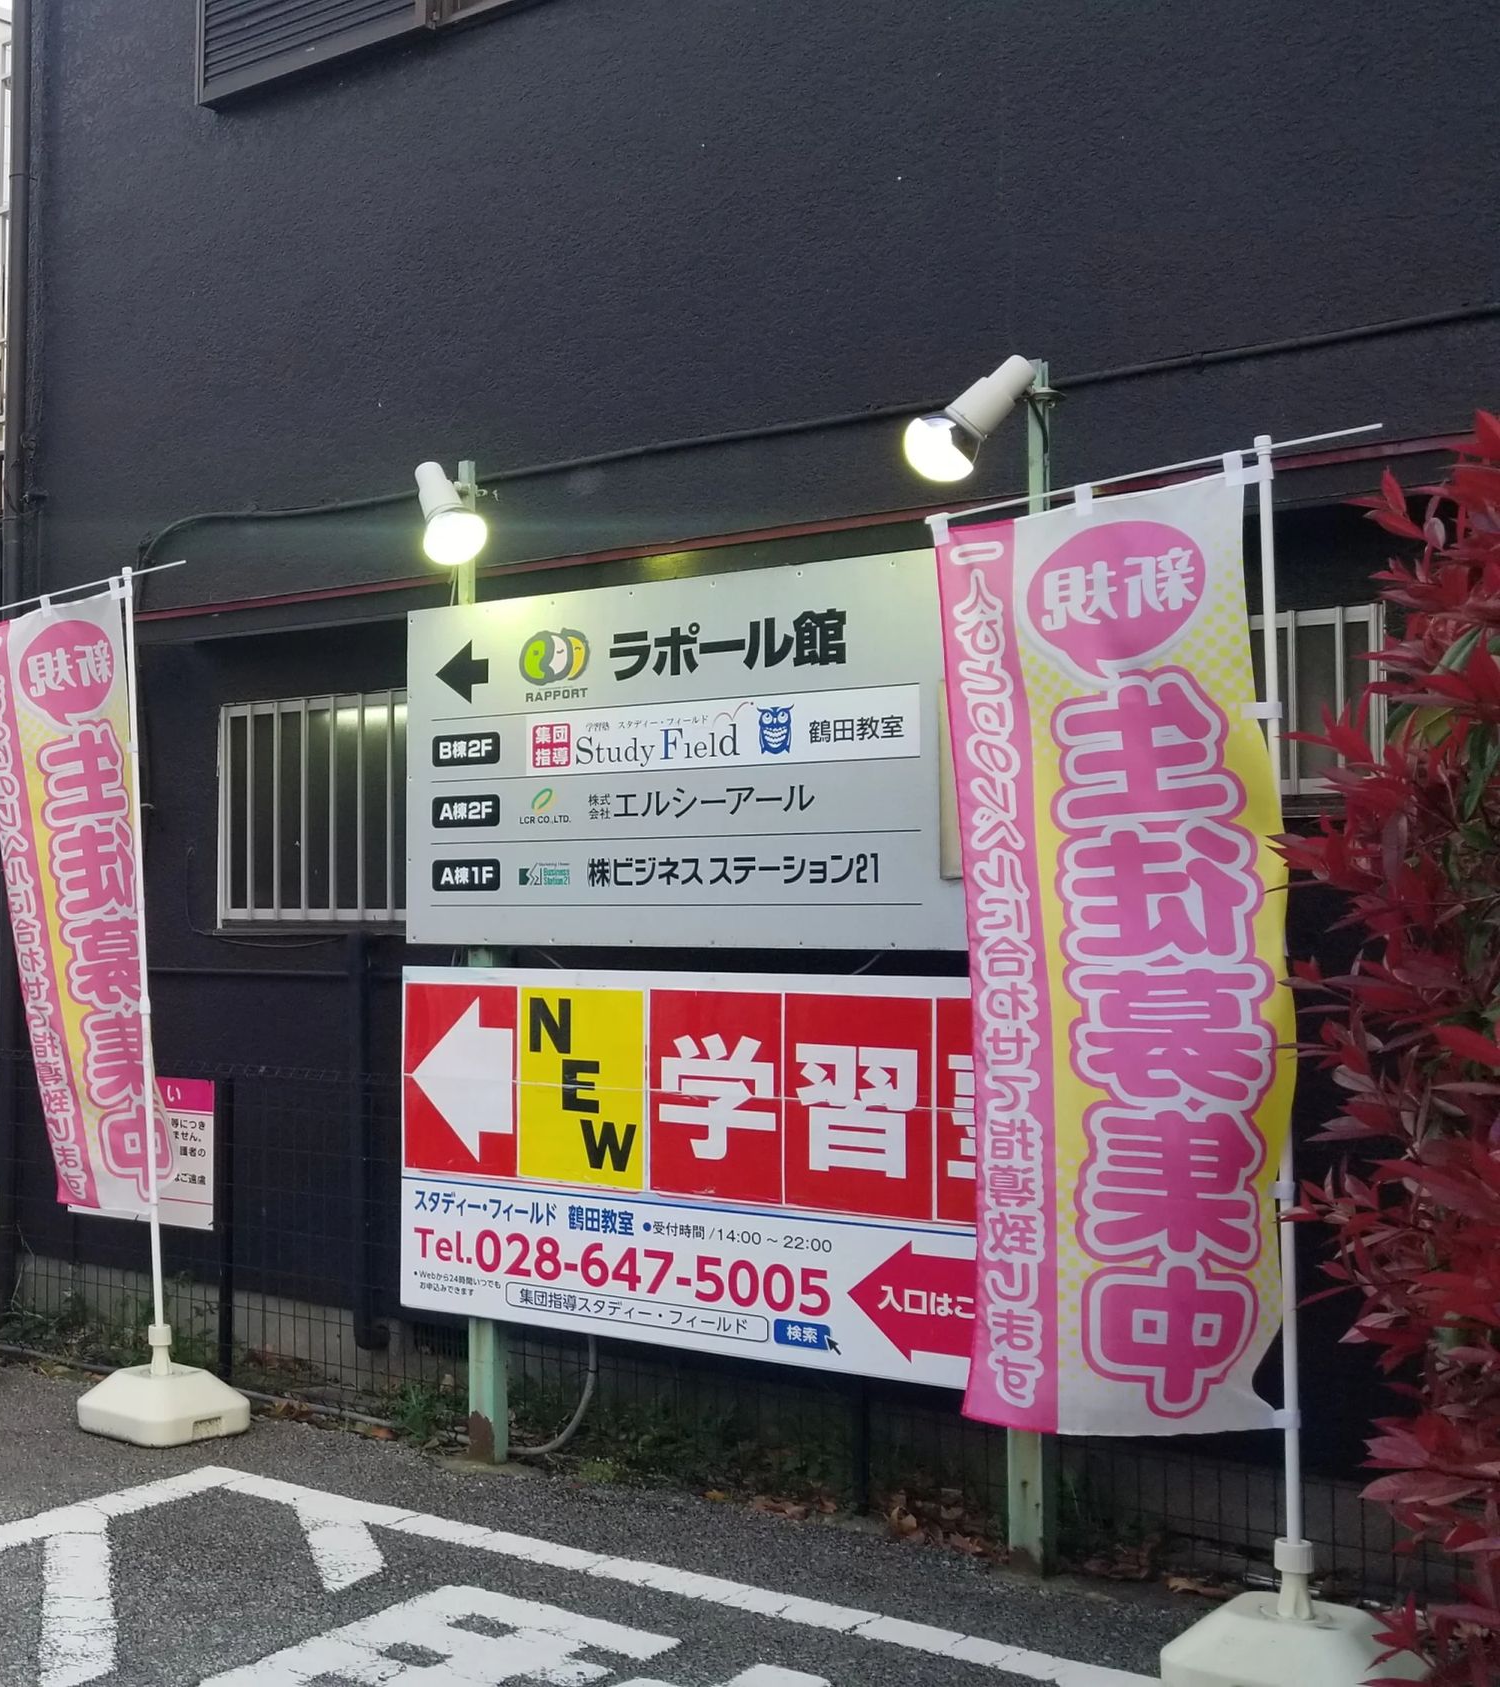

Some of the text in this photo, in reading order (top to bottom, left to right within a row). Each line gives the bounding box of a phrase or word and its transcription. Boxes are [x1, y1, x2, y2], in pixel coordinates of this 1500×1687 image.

[609, 608, 847, 681] ラポール館
[525, 687, 589, 702] RAPPORT
[618, 715, 709, 730] スタディー・フィールド
[808, 714, 905, 745] 鶴田教室
[535, 725, 568, 745] 集団
[575, 724, 740, 767] Study Field
[438, 739, 493, 760] B棟2F
[535, 747, 568, 767] 指導
[588, 793, 611, 806] 株式
[614, 784, 815, 819] エルシーアール
[438, 800, 493, 822] A棟2F
[519, 816, 535, 824] LCR
[588, 808, 611, 820] 会社
[440, 864, 494, 887] A棟1F
[414, 1190, 635, 1237] スタディー・フィールド 鶴田教室
[519, 1287, 748, 1336] 集団指導スタディー・フィールド
[785, 1323, 819, 1345] 検索
